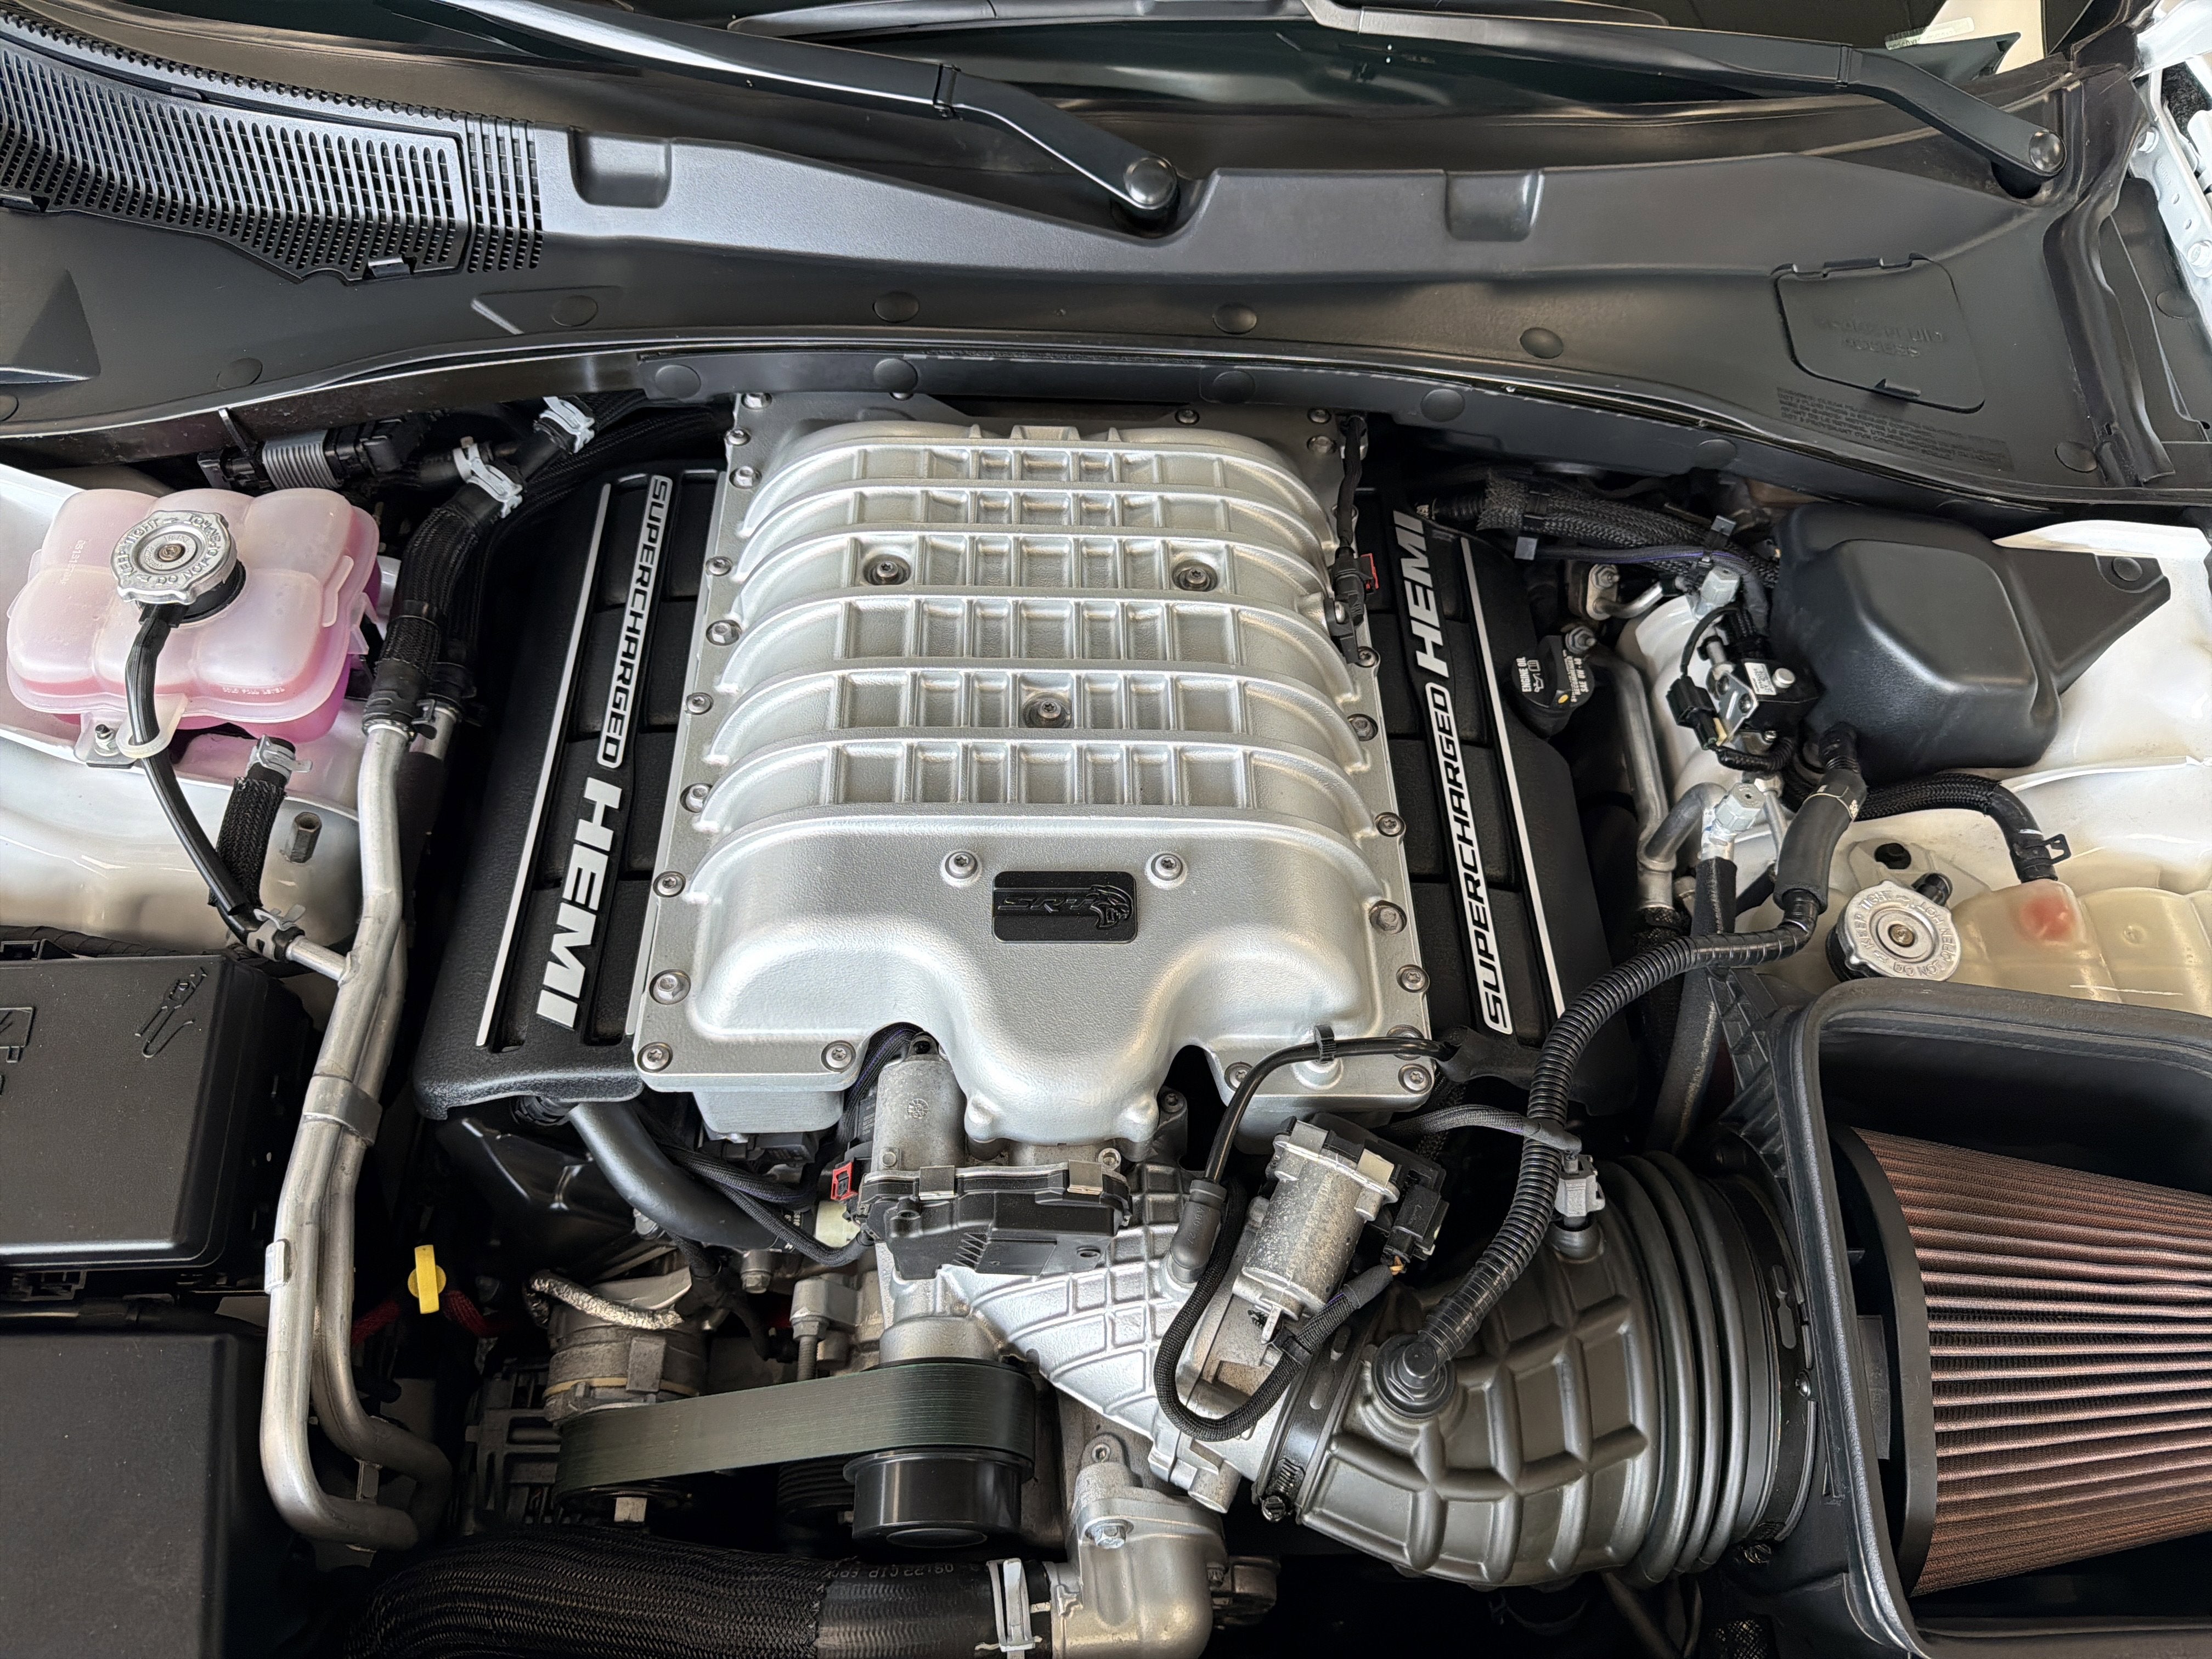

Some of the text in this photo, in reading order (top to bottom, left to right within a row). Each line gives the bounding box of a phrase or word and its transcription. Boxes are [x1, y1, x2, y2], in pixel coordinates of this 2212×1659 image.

[125, 518, 159, 544] TIGHT
[1516, 657, 1532, 692] ENGINE OIL
[1566, 656, 1581, 696] RECOMMENDED
[1578, 681, 1589, 693] SAE
[535, 476, 673, 1030] SUPERCHARGED HEMI
[1393, 510, 1513, 1035] HEMI SUPERCHARGED
[997, 896, 1098, 913] SRT
[1854, 890, 1892, 949] KEEP TIGHT
[1893, 901, 1957, 977] DO NOT OPEN HOT
